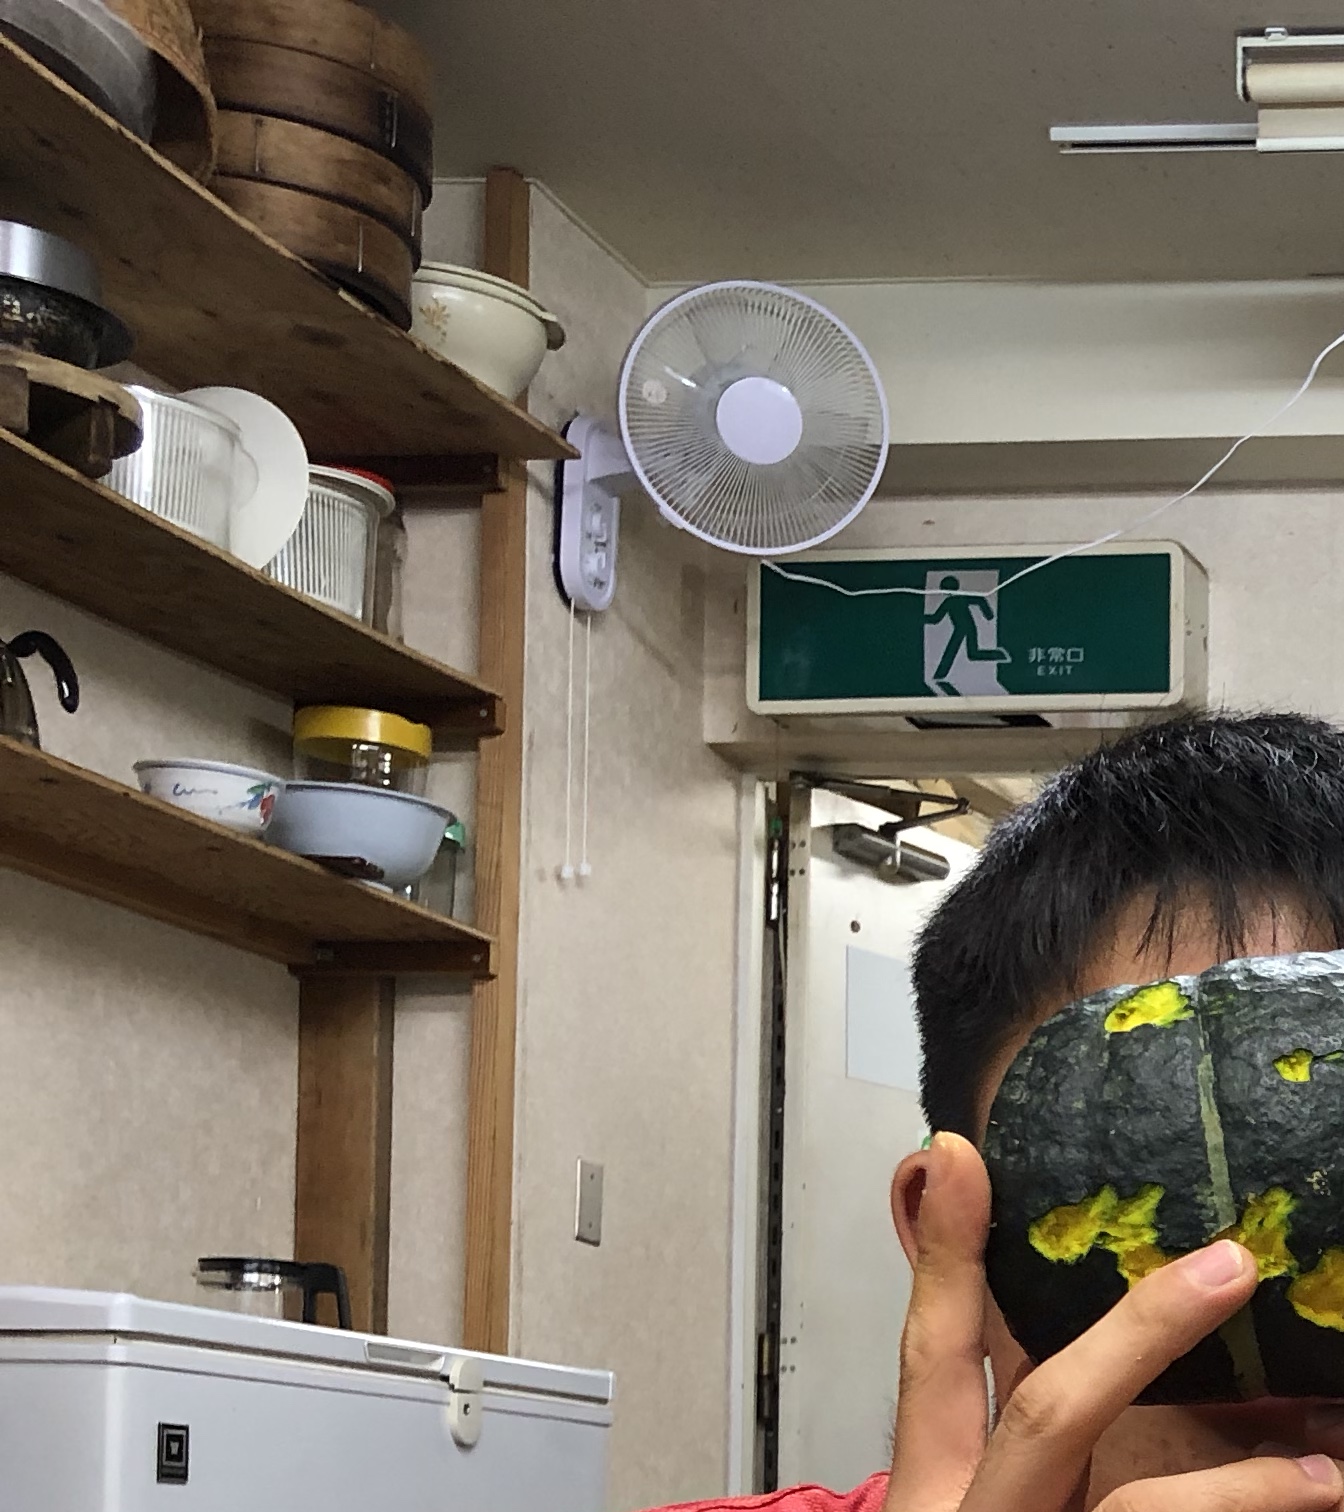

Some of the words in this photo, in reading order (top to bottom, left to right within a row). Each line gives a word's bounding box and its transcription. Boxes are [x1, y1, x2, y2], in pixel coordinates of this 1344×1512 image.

[1028, 647, 1084, 663] 非常口
[1037, 665, 1073, 676] EXIT
